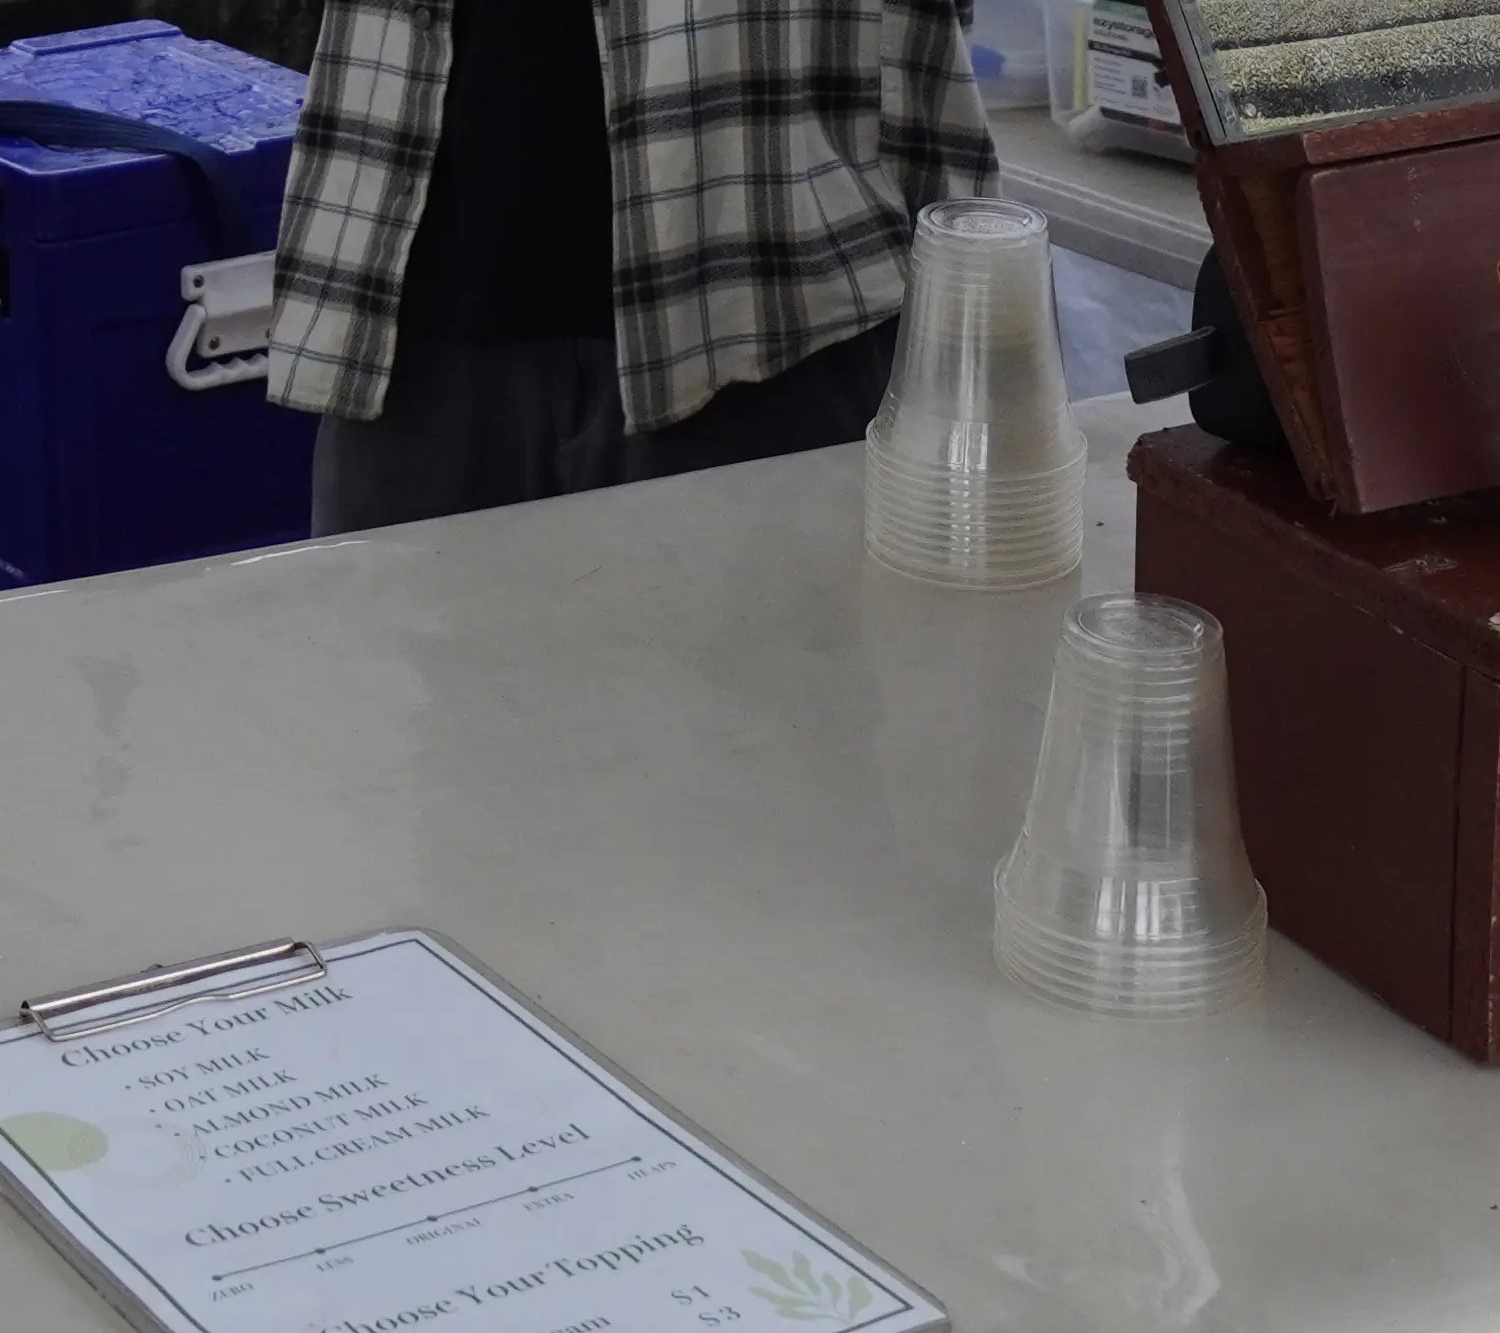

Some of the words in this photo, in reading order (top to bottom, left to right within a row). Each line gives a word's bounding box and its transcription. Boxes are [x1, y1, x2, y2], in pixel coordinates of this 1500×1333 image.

[60, 1031, 181, 1068] Choose
[185, 1007, 268, 1036] Your
[273, 985, 353, 1015] Milk
[136, 1068, 193, 1090] SOY
[195, 1047, 270, 1075] MILK
[163, 1090, 220, 1113] OAT
[222, 1069, 297, 1095] MILK
[189, 1092, 318, 1137] ALMOND
[313, 1074, 390, 1106] MILK
[212, 1117, 333, 1160] COCONUT
[335, 1095, 428, 1127] MILK
[238, 1149, 313, 1184] FULL
[312, 1126, 413, 1164] CREAM
[414, 1105, 490, 1132] MILK
[184, 1206, 313, 1247] Choose
[317, 1156, 497, 1213] Sweetness
[495, 1123, 591, 1162] Level
[319, 1299, 454, 1333] Choose
[456, 1264, 550, 1306] Your
[547, 1223, 706, 1279] Topping
